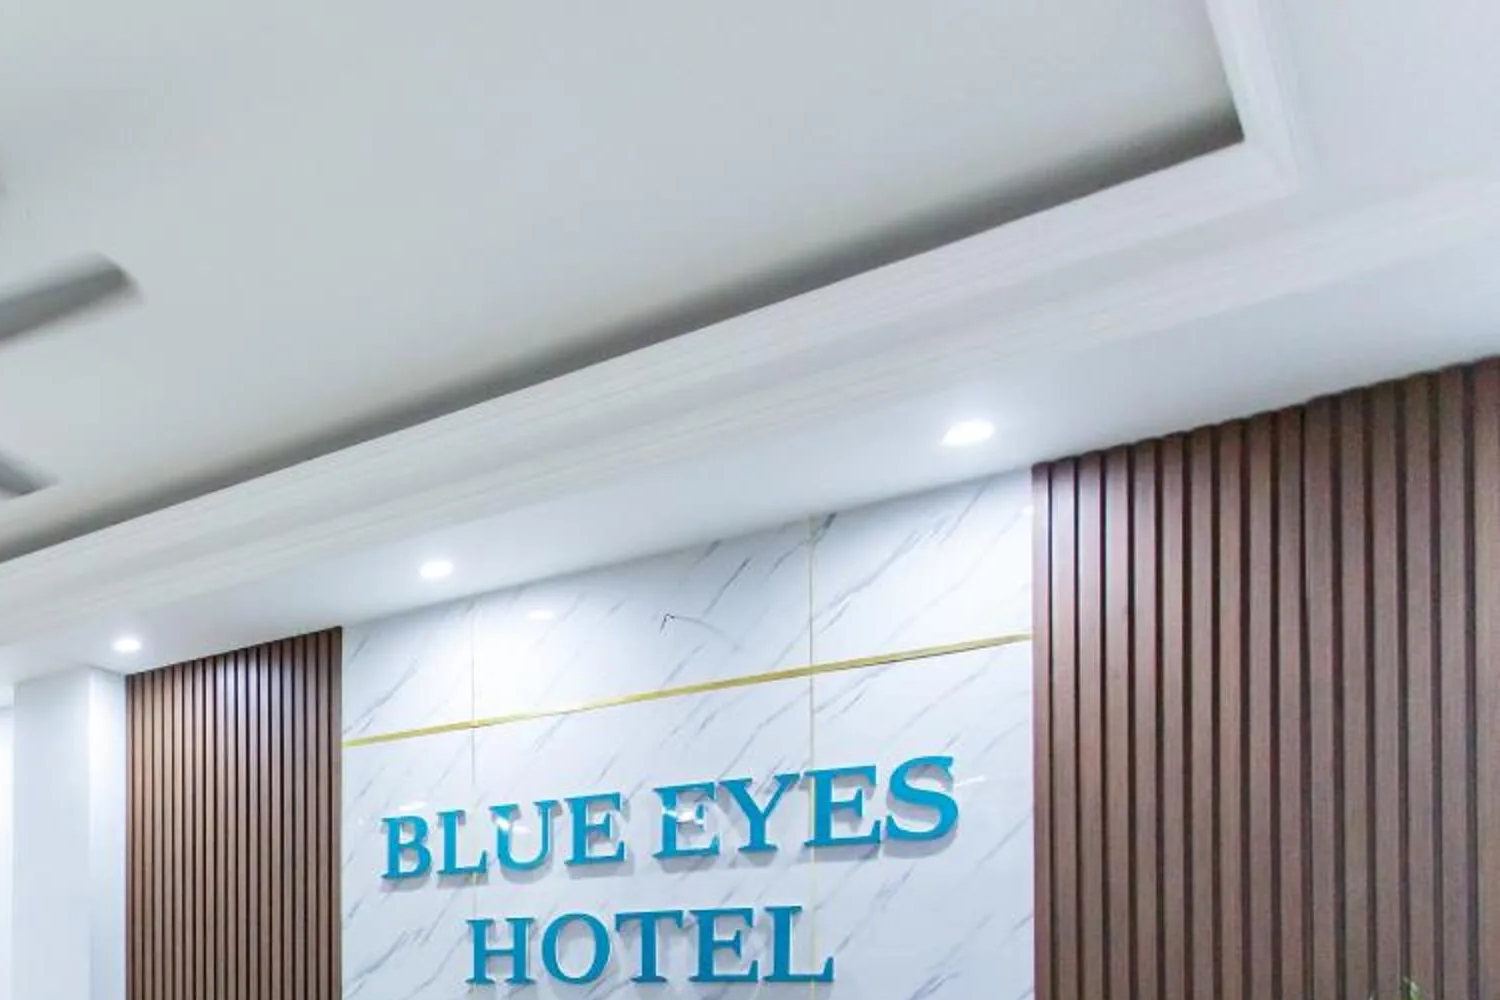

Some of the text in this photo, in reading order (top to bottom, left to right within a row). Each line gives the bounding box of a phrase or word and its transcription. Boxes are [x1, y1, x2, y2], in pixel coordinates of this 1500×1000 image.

[381, 756, 959, 880] BLUE EYES
[466, 905, 834, 986] HOTEL
